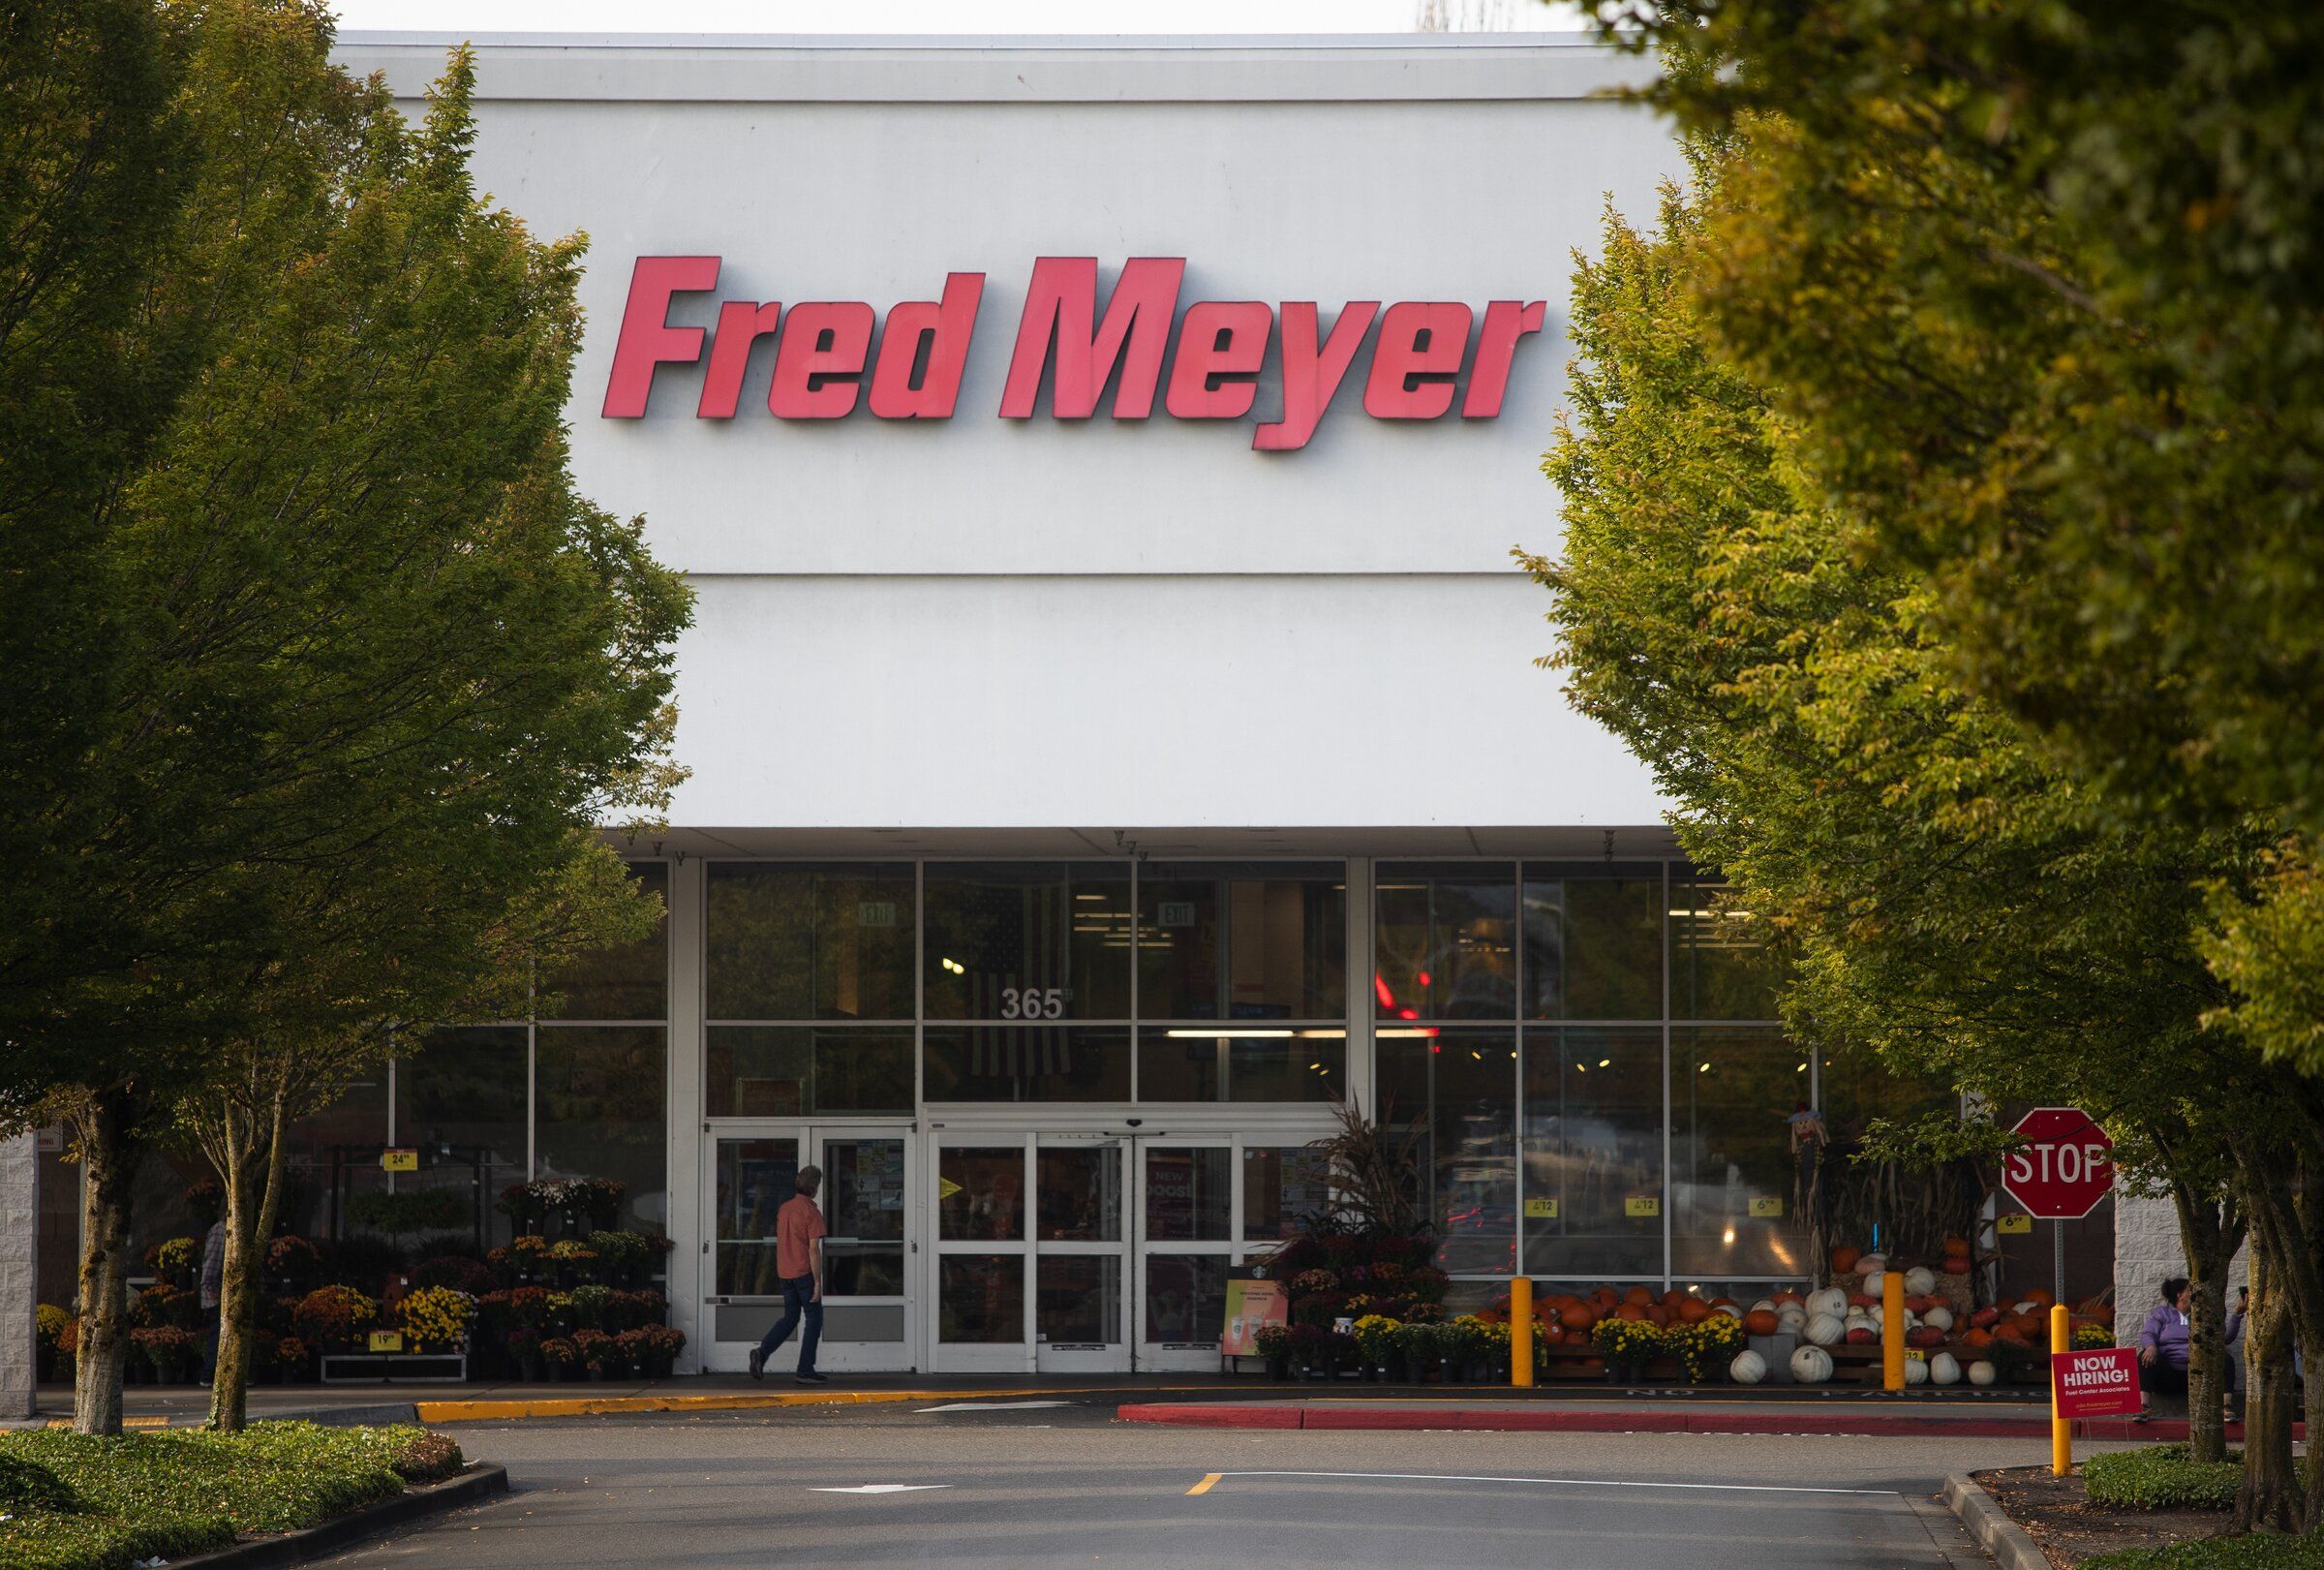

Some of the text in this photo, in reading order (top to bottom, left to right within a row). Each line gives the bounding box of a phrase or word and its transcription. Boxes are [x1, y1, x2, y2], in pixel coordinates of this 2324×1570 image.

[600, 256, 1547, 451] Fred Meyer
[1165, 906, 1189, 923] EXIT
[1000, 987, 1063, 1020] 365
[2010, 1143, 2107, 1184] STOP
[2073, 1356, 2117, 1372] NOW
[2064, 1369, 2129, 1387] HIRING!
